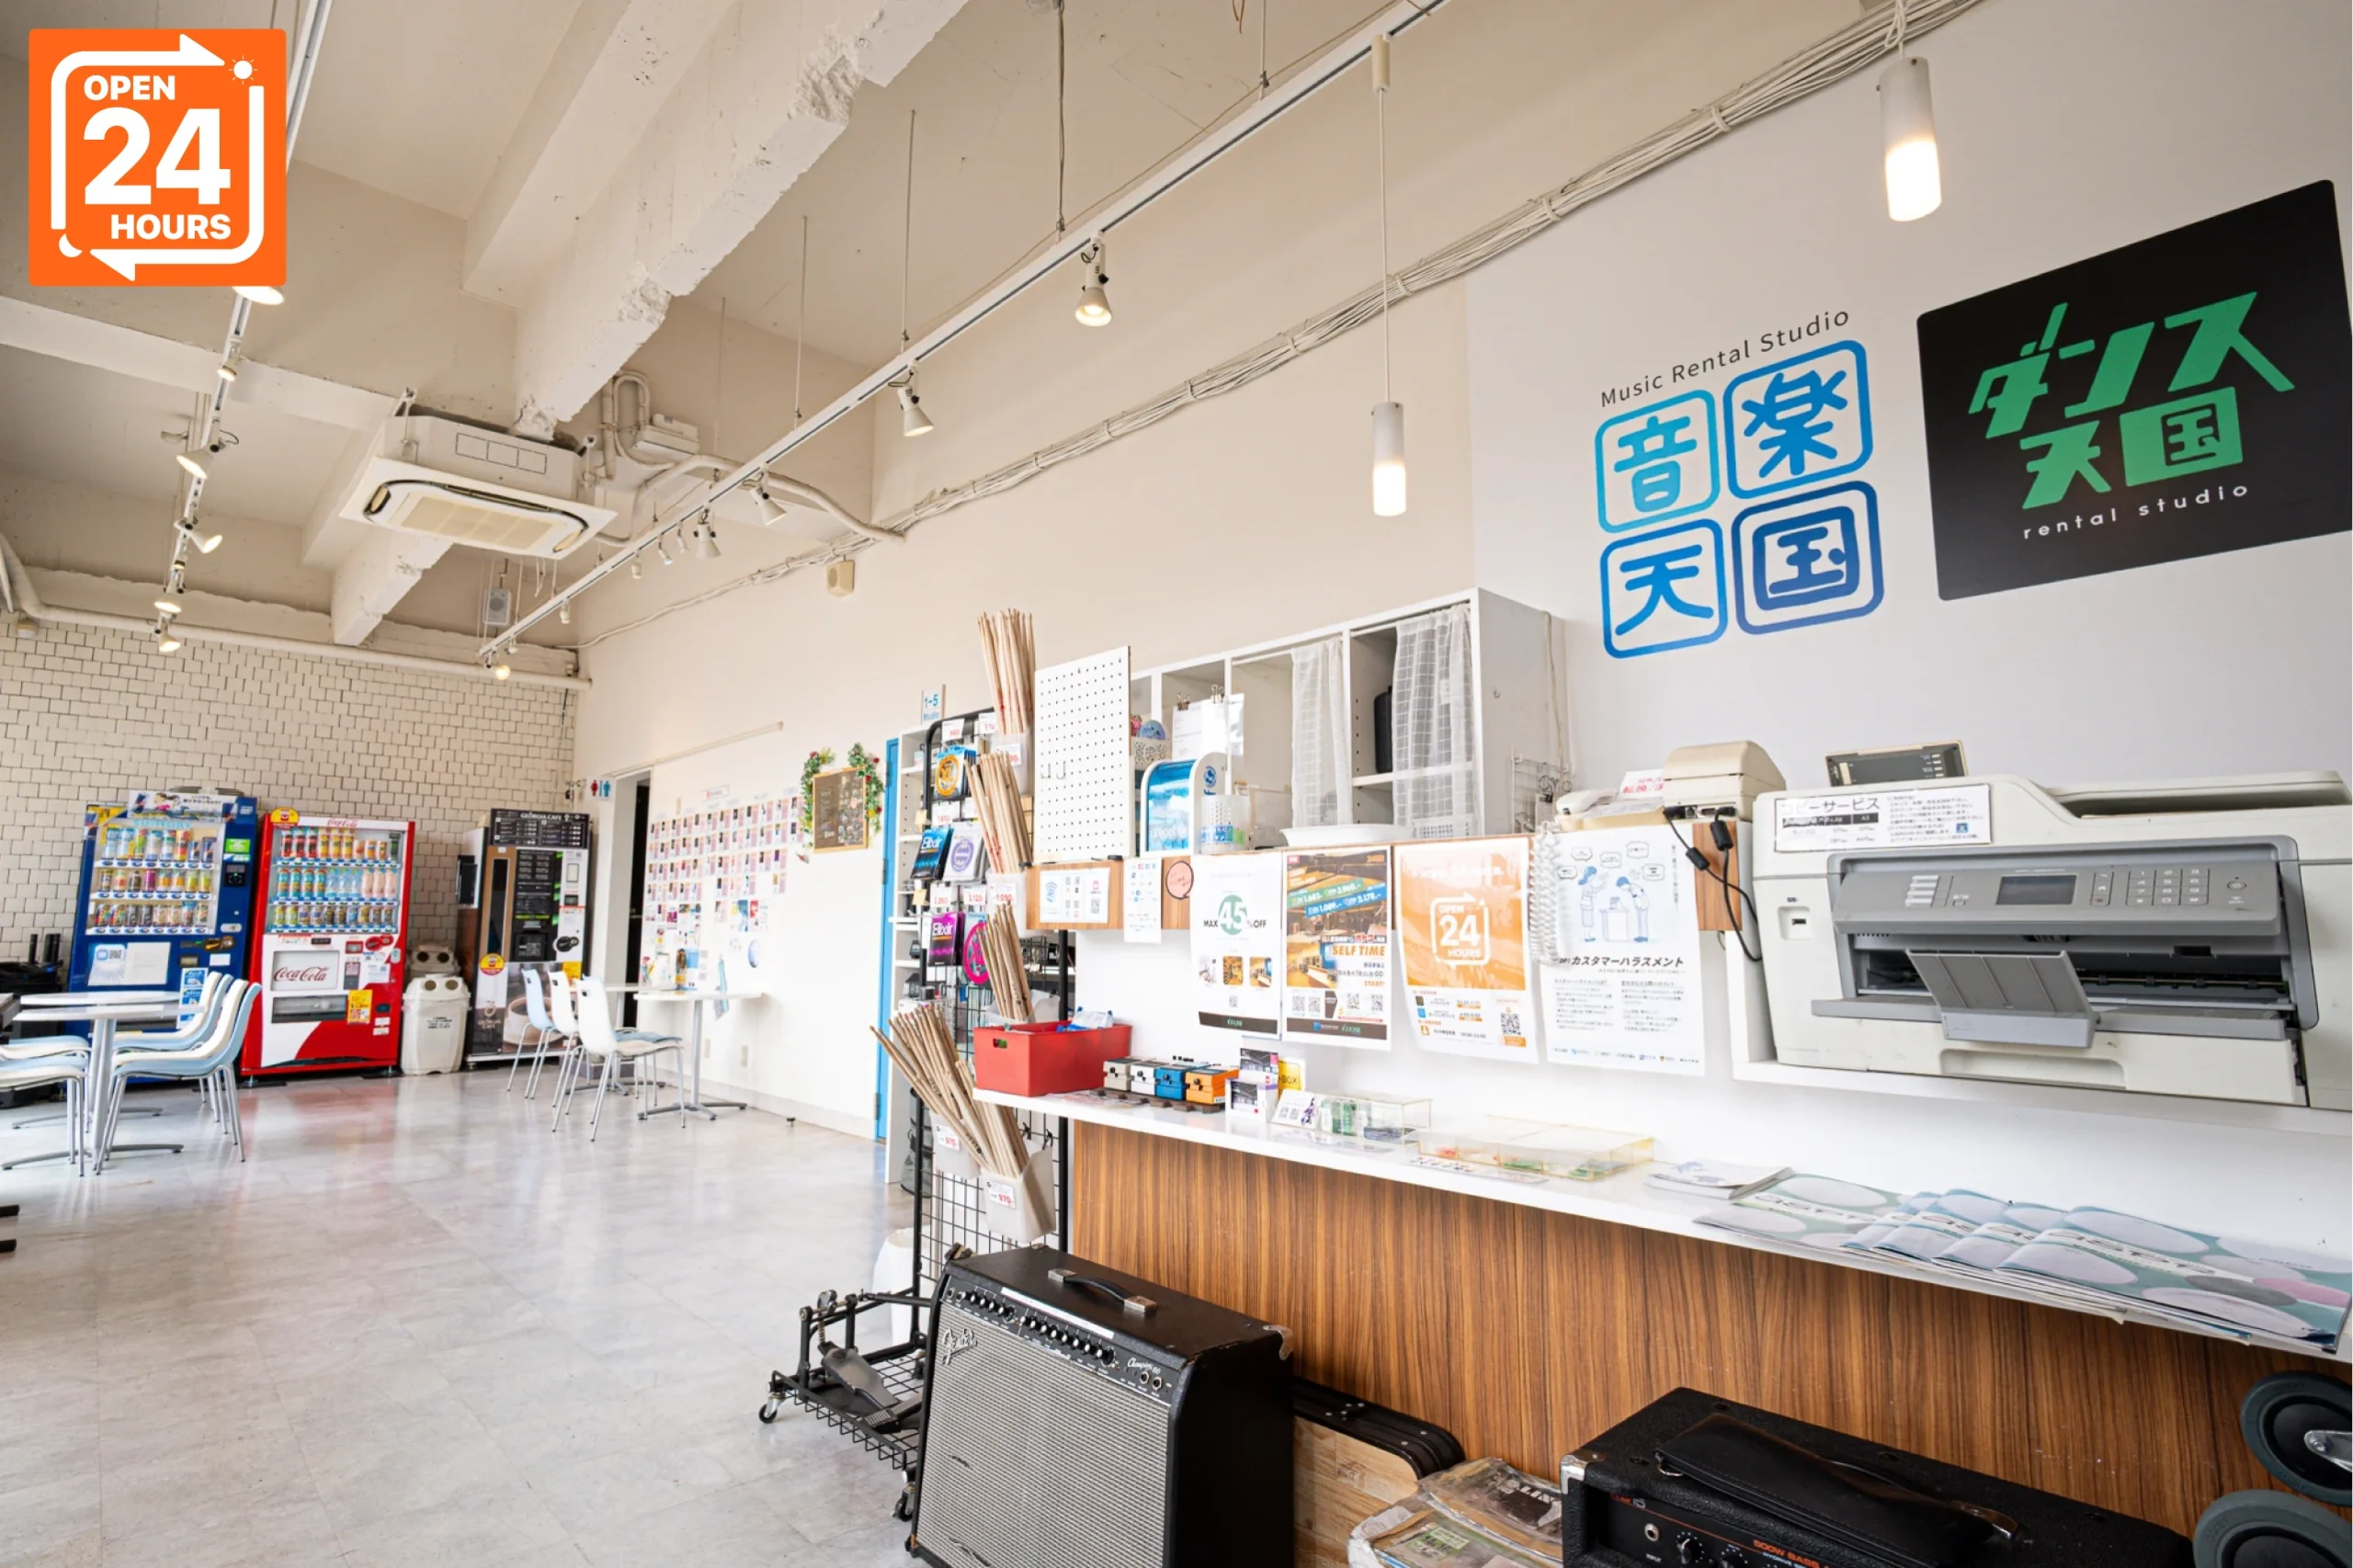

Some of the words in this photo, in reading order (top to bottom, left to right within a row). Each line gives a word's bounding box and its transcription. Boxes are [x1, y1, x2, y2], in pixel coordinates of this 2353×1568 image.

[1601, 375, 1663, 407] Music
[1672, 339, 1750, 383] Rental
[1760, 311, 1849, 352] Studio
[1968, 291, 2295, 439] ダンス
[1614, 369, 1847, 513] 音楽
[2019, 386, 2243, 509] 天国
[2024, 507, 2117, 539] rental
[2139, 485, 2247, 517] studio
[1615, 506, 1860, 636] 天国
[921, 836, 943, 849] Elixir
[1203, 919, 1219, 928] MAX
[1220, 901, 1247, 931] 45
[1438, 904, 1464, 915] OPEN
[932, 922, 954, 936] Elixir
[1438, 915, 1481, 948] 24
[1332, 945, 1357, 956] SELF
[1358, 945, 1386, 956] TIME
[1448, 949, 1482, 959] HOURS
[1571, 955, 1685, 968] カスタマーハラスメント
[273, 967, 330, 982] Coca-Cola
[1753, 1539, 1785, 1557] 500W
[1787, 1551, 1821, 1568] BASS
